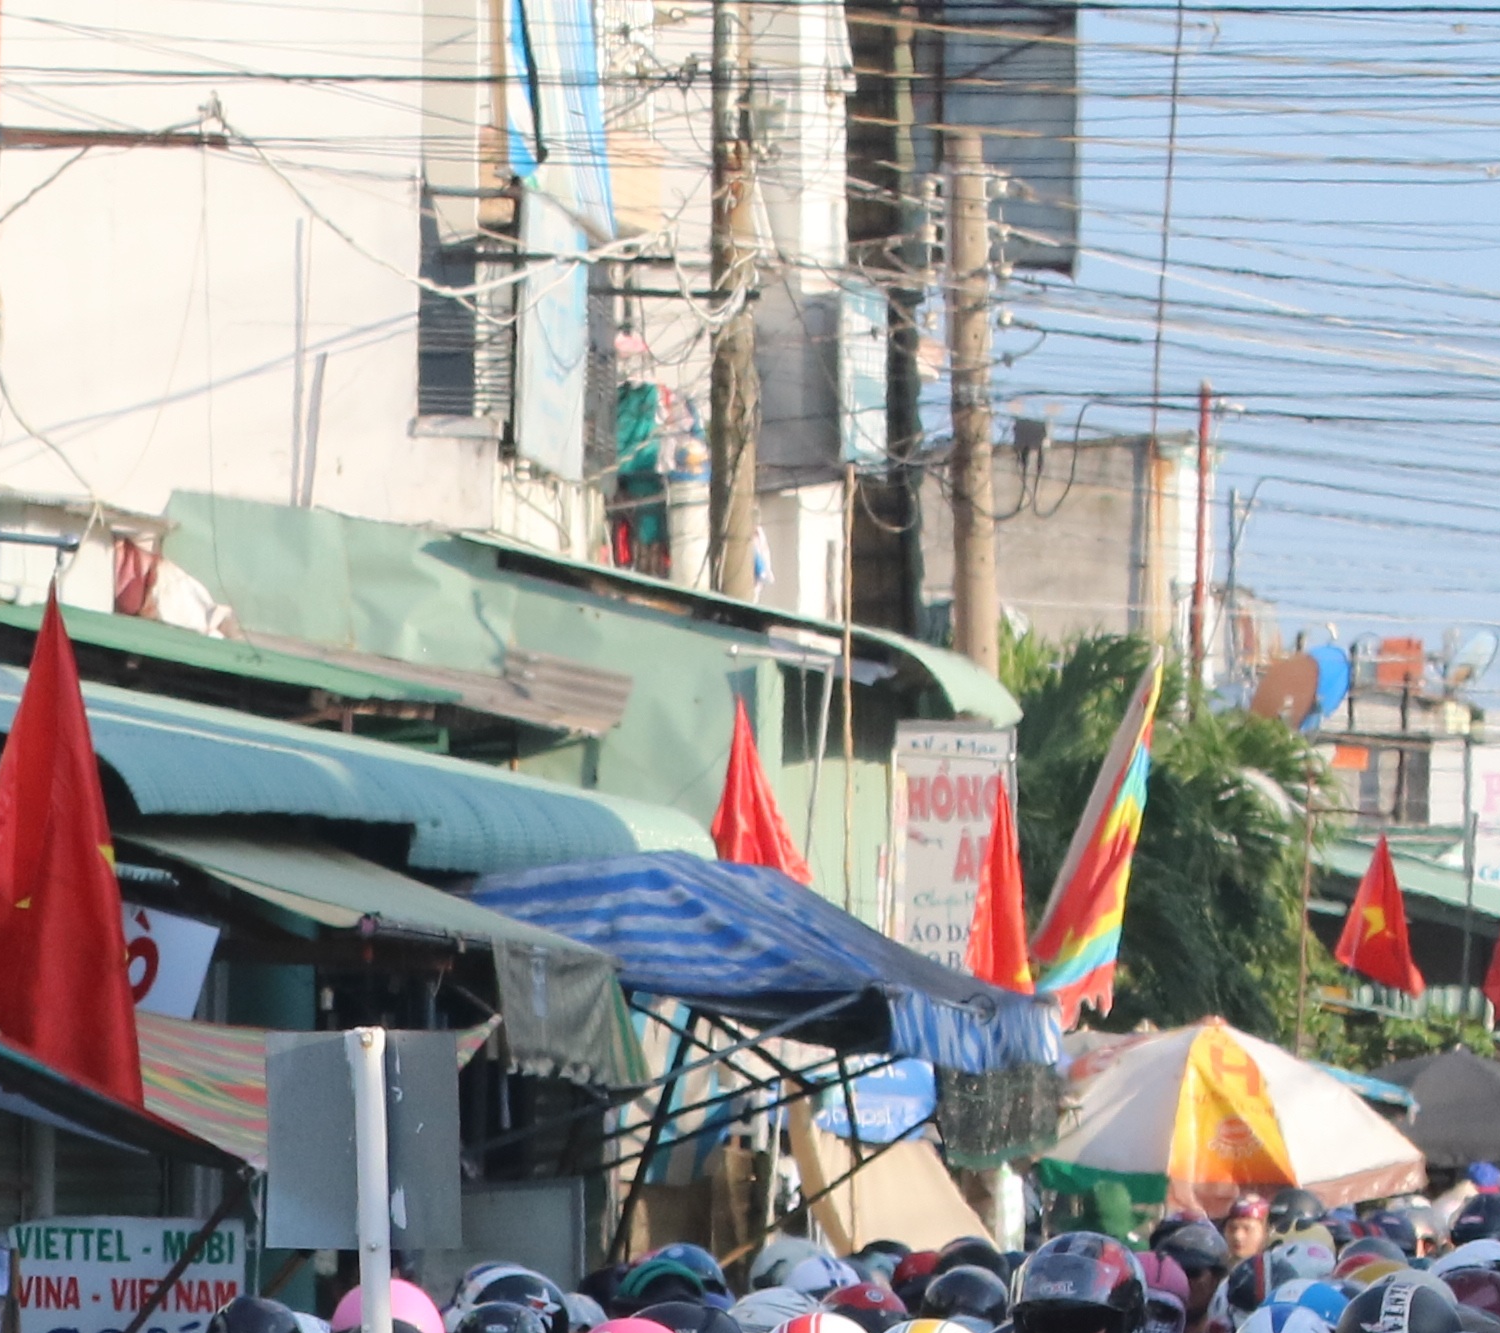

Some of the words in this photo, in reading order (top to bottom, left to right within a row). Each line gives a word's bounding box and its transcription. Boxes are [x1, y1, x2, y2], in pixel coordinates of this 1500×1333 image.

[16, 1226, 131, 1262] VIETTEL
[162, 1230, 235, 1265] MOBI
[19, 1276, 81, 1310] VINA
